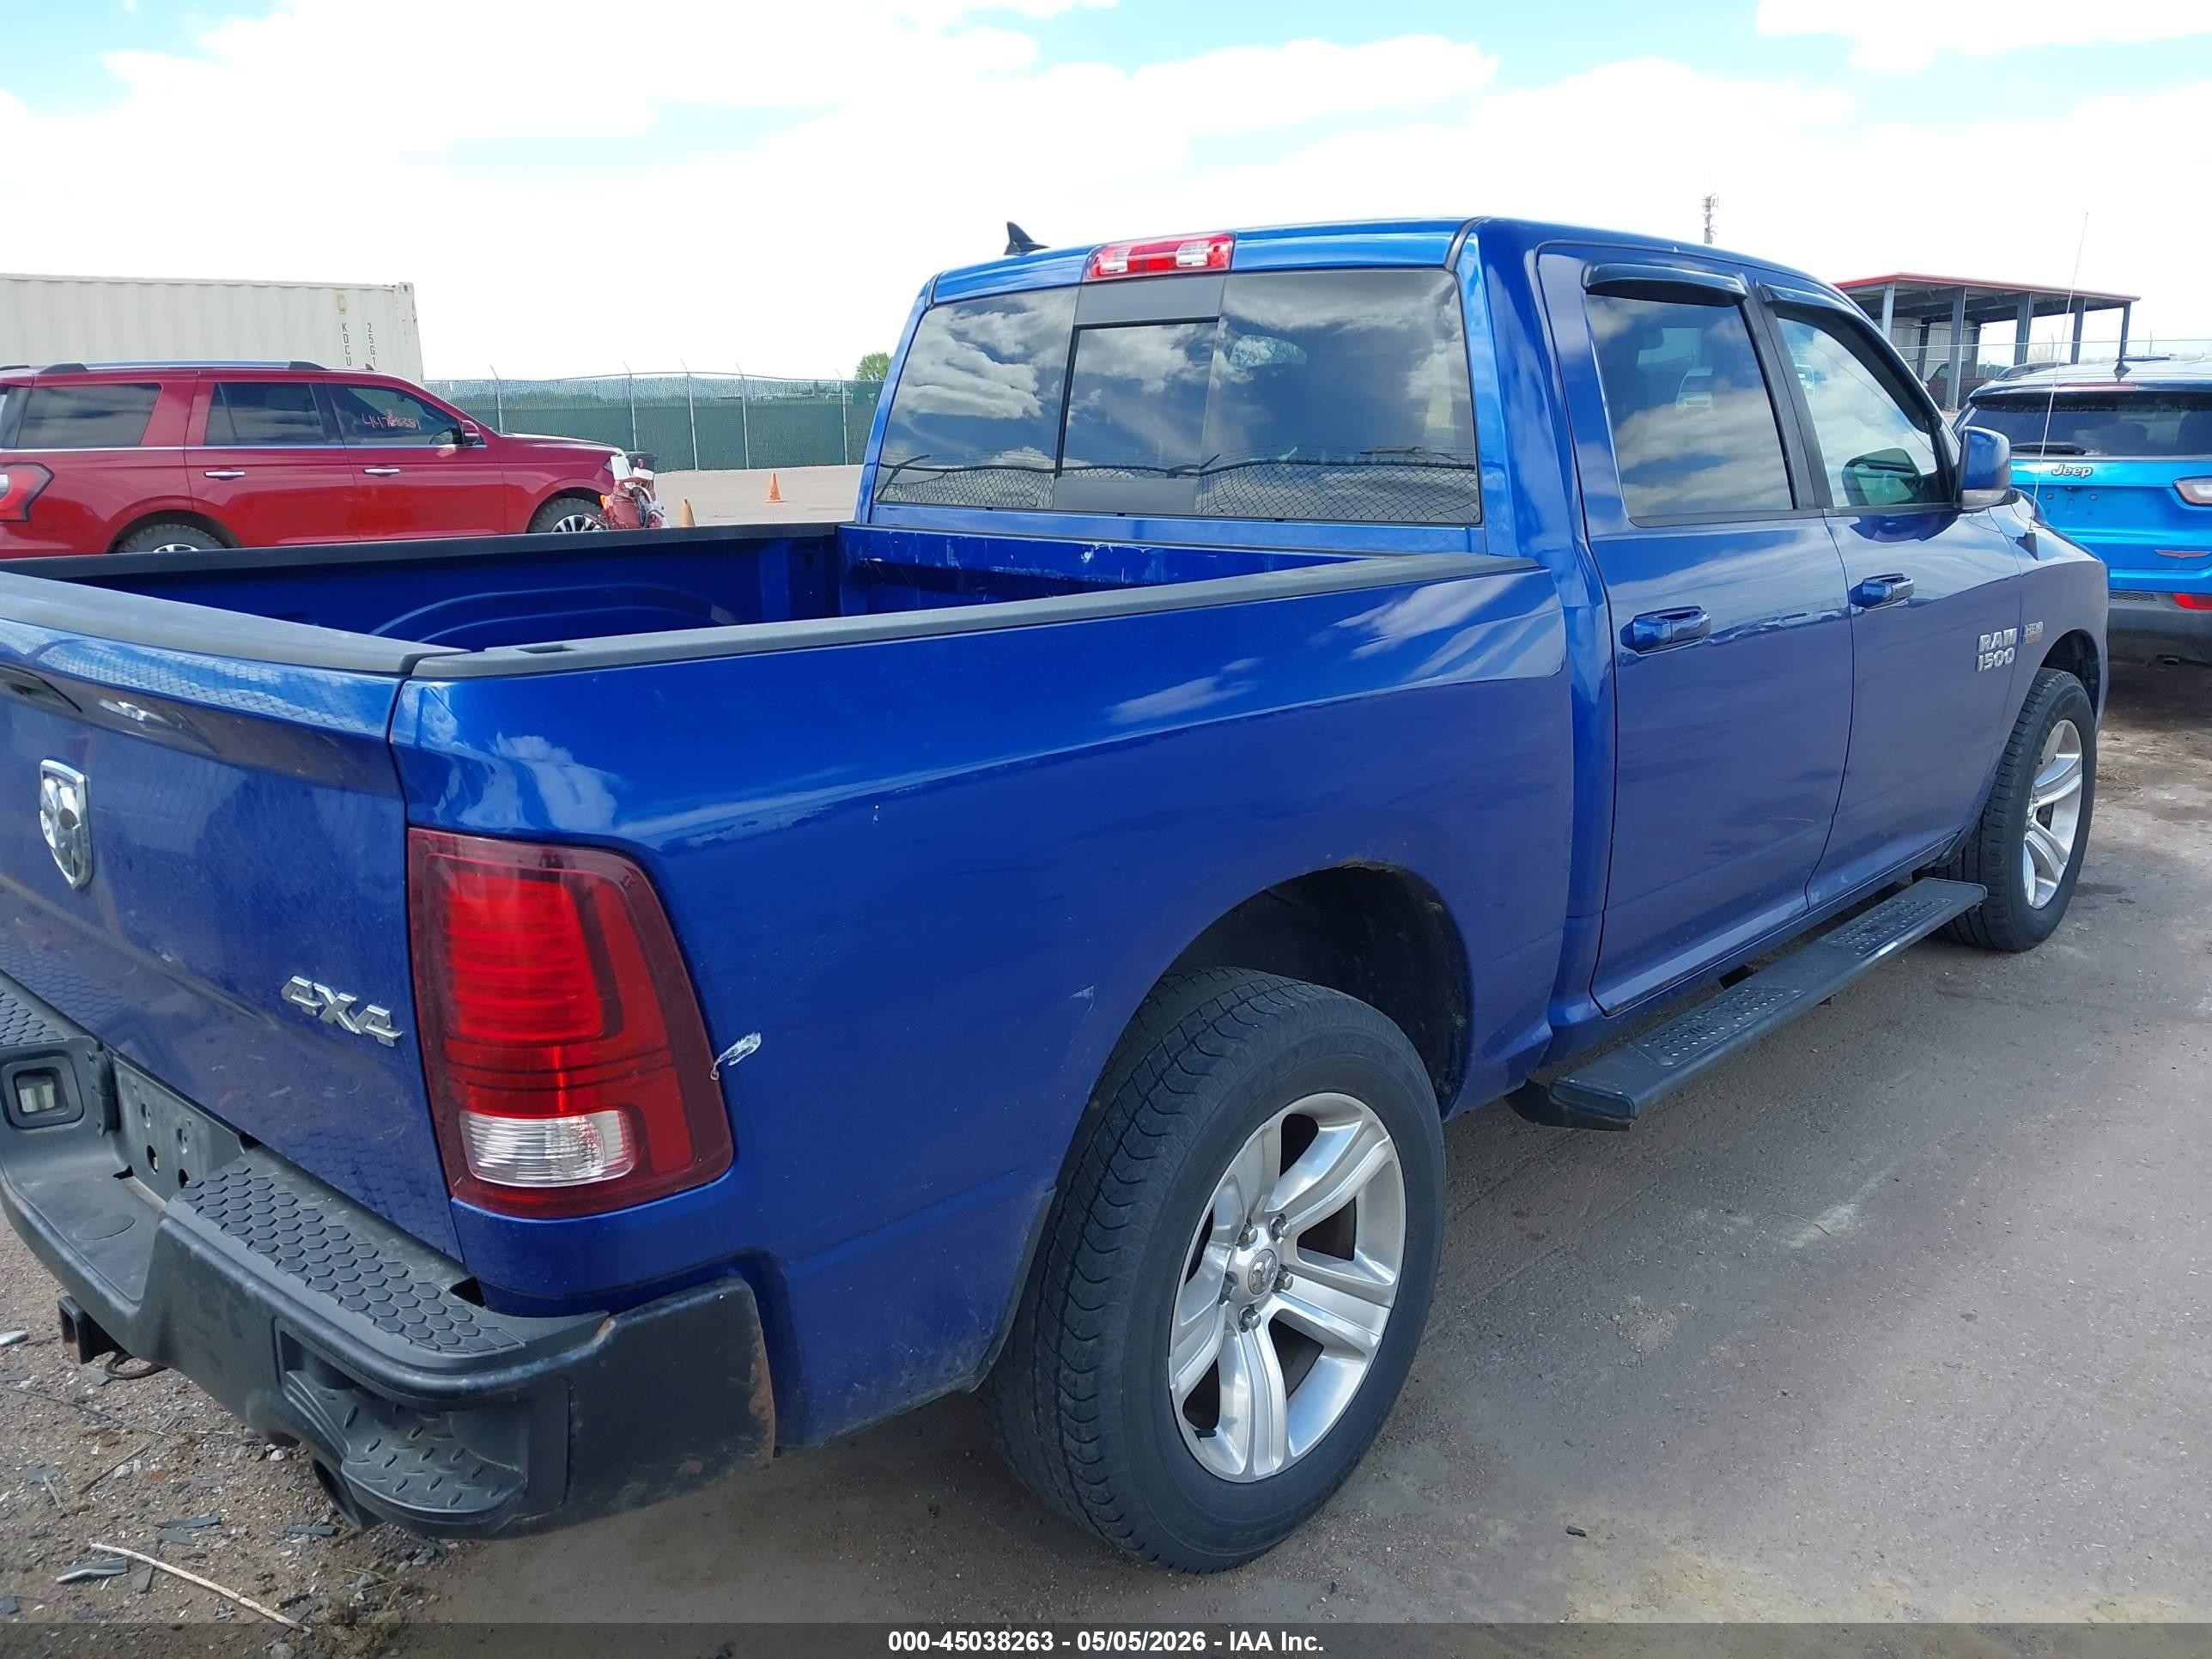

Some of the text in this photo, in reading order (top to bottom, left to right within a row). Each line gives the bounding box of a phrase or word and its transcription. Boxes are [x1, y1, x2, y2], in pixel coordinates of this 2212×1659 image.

[341, 322, 352, 367] KDCU
[367, 322, 377, 367] 25G1
[2051, 464, 2094, 478] Jeep
[1978, 628, 2017, 652] RAM
[1978, 647, 2014, 672] 1500
